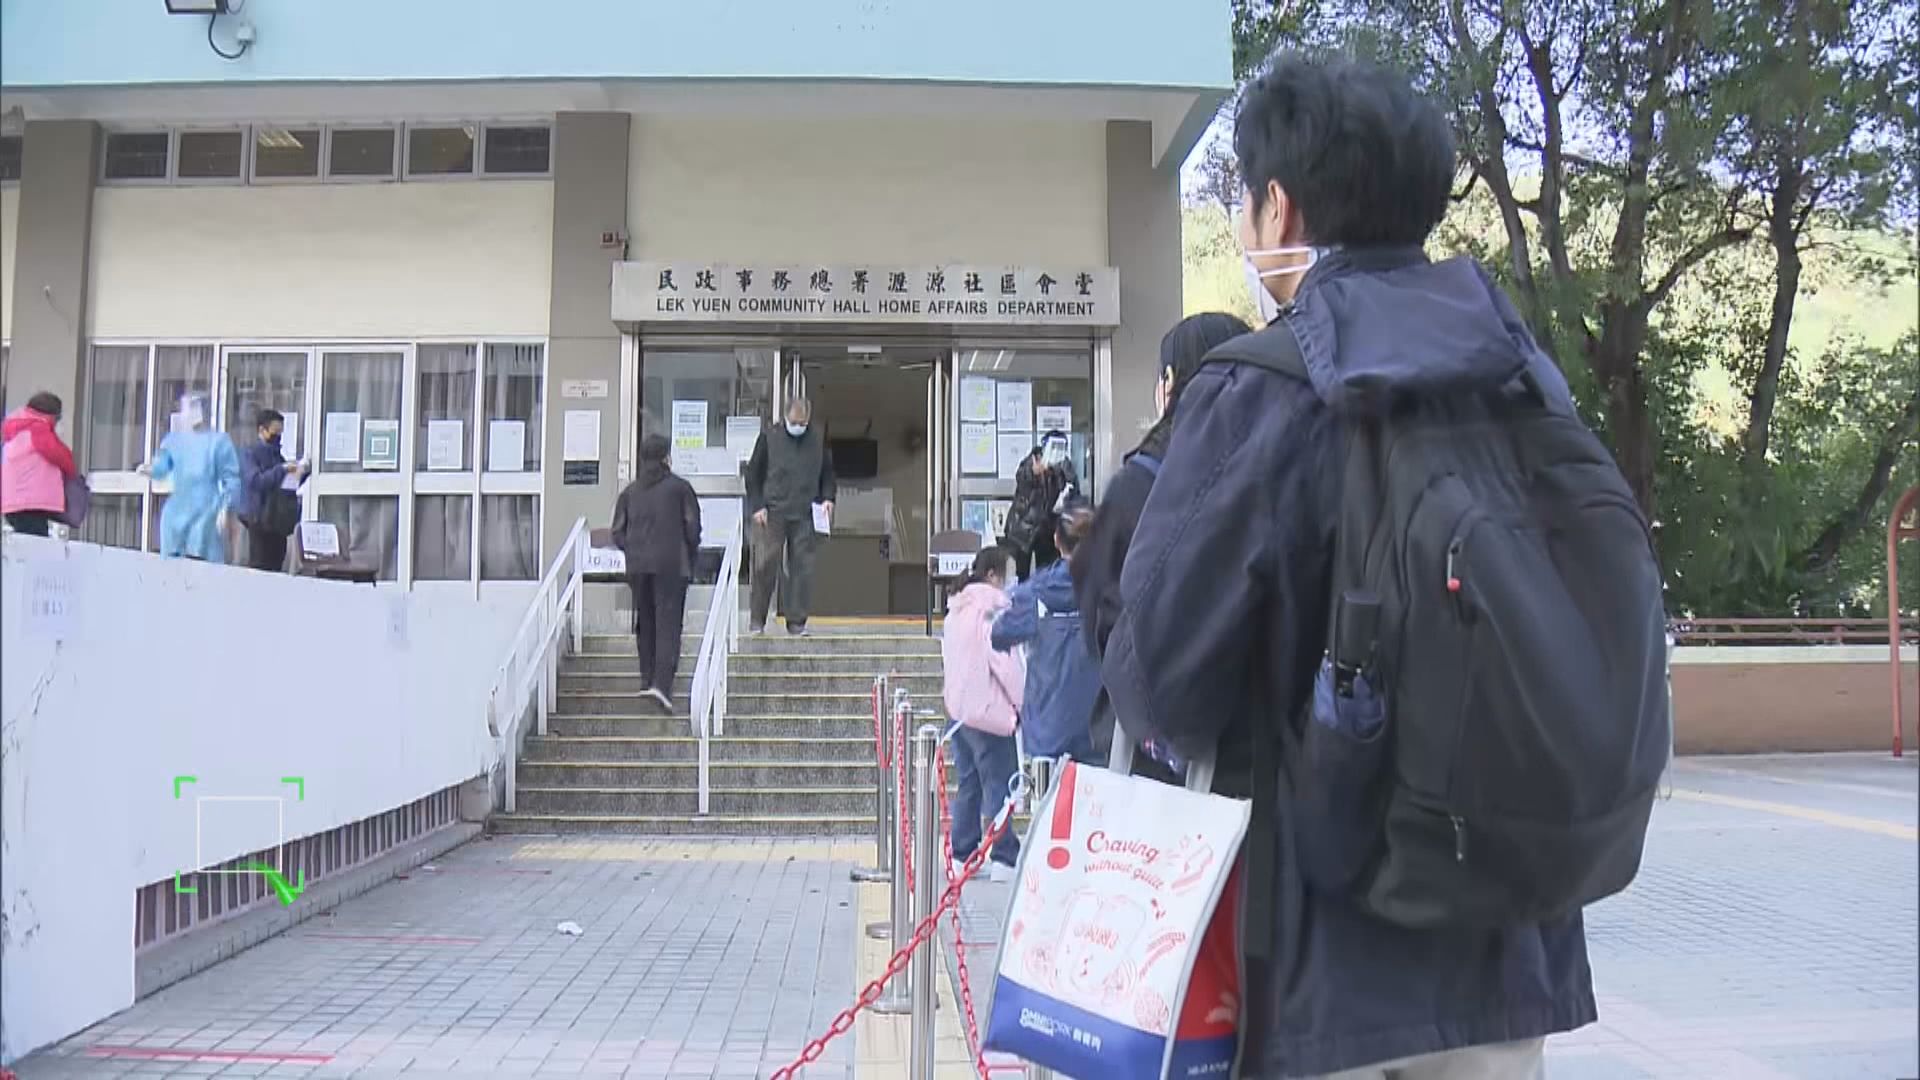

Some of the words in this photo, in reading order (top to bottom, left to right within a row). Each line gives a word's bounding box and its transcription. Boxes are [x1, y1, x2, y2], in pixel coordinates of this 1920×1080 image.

[657, 298, 685, 312] LEK
[692, 298, 731, 313] YUEN
[738, 298, 825, 313] COMMUNITY
[833, 300, 871, 314] HALL
[878, 300, 921, 314] HOME
[927, 301, 988, 315] AFFAIRS
[998, 302, 1095, 316] DEPARTMENT
[1087, 830, 1160, 864] Craving
[1084, 860, 1133, 874] without
